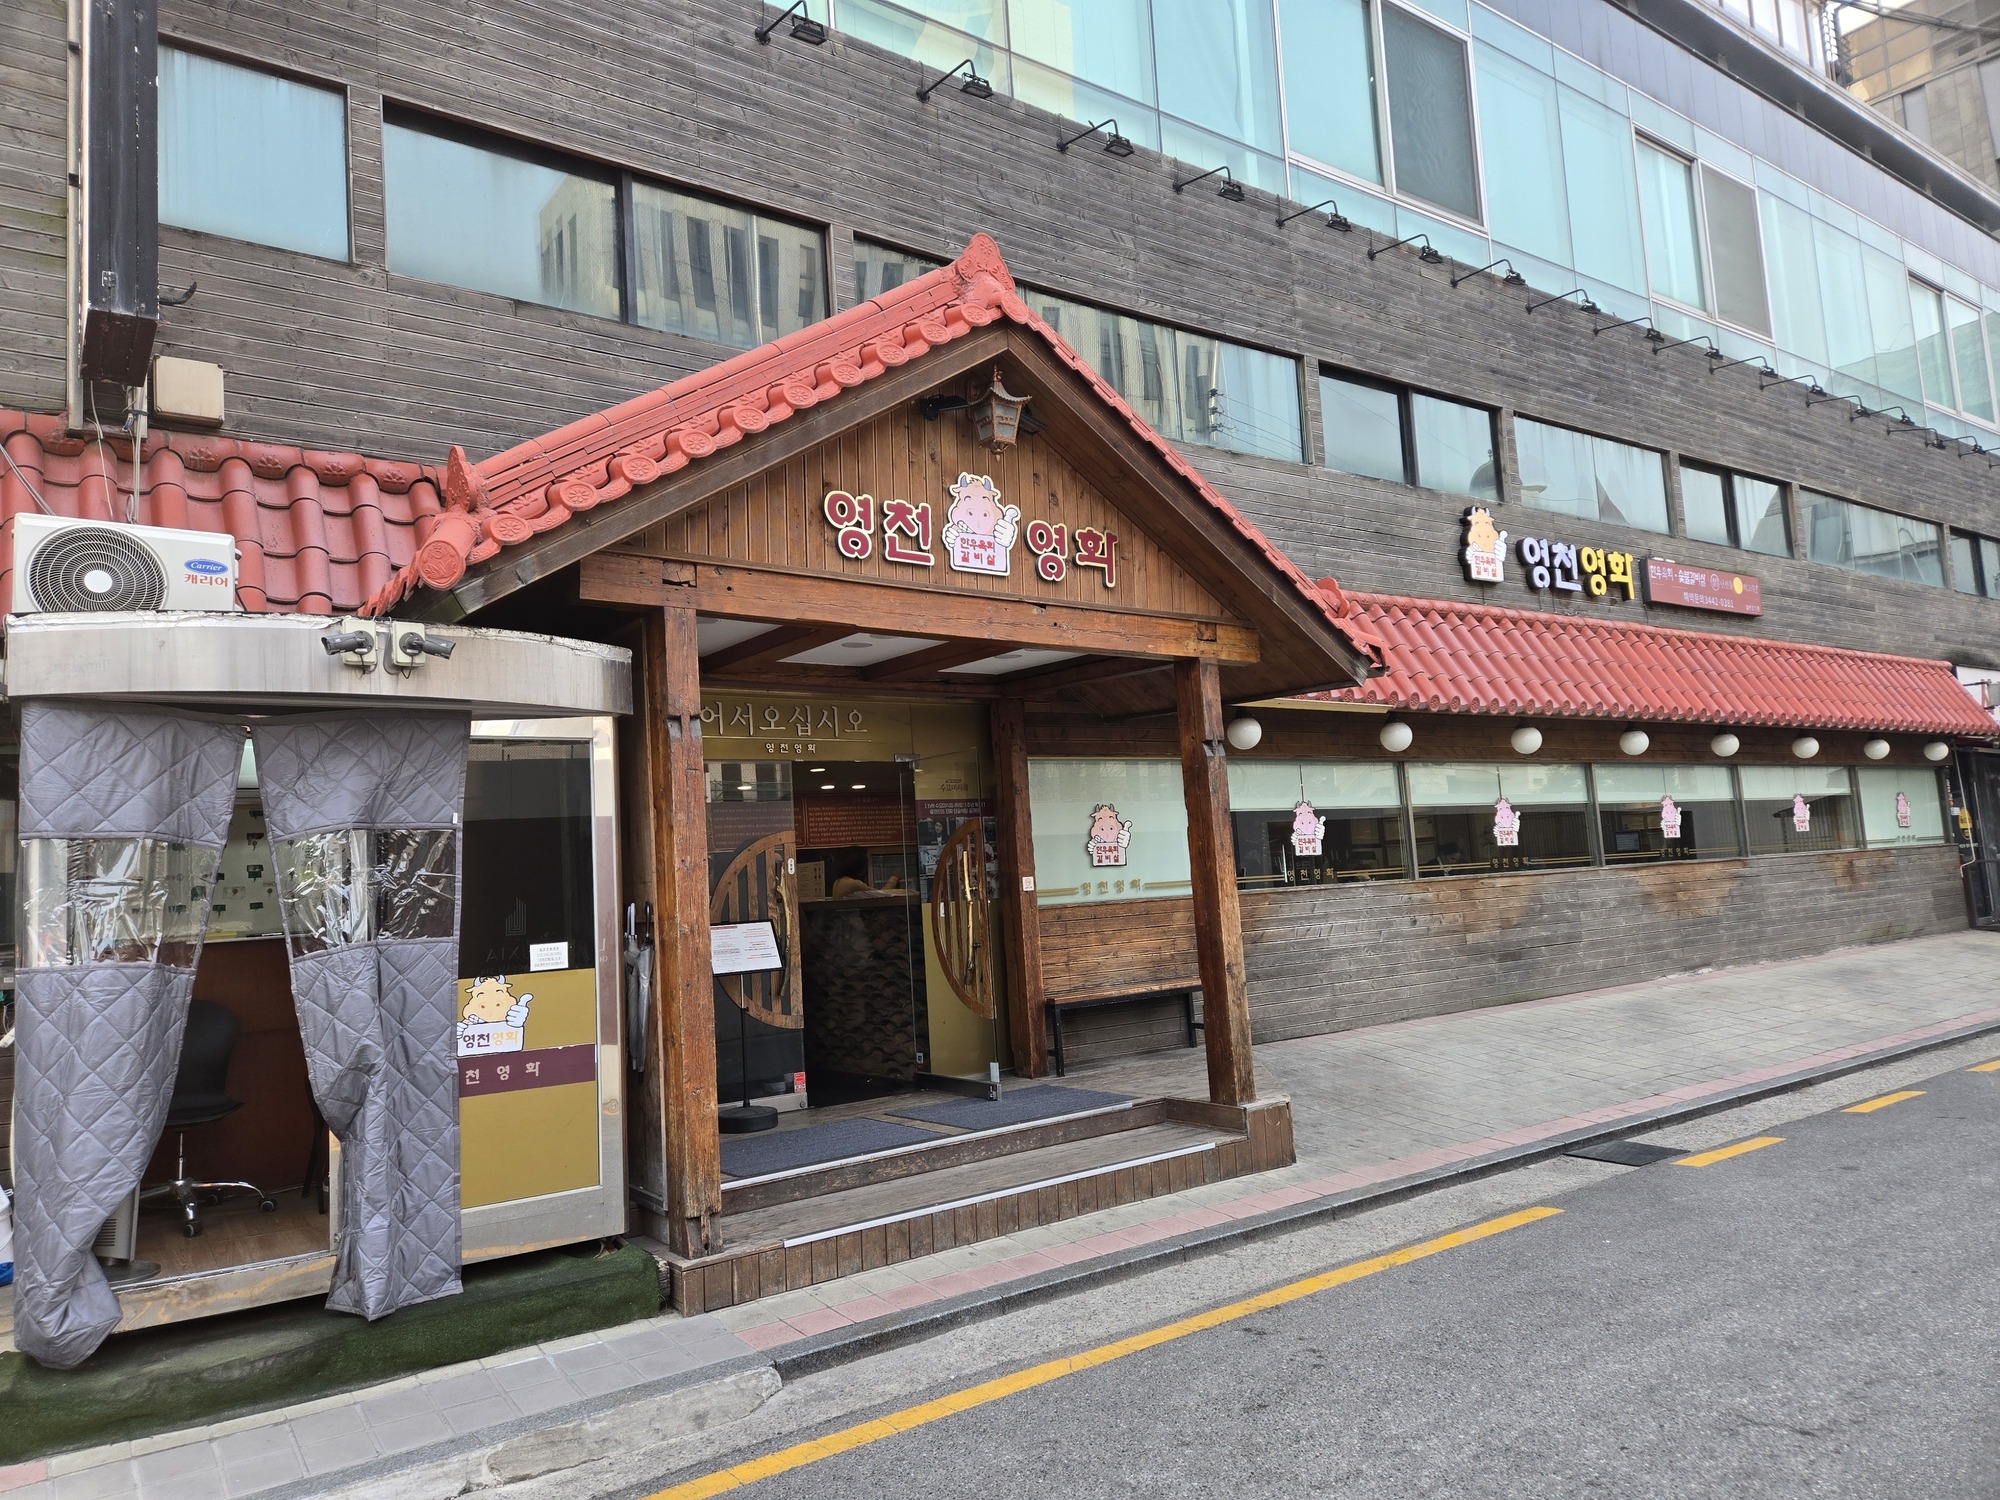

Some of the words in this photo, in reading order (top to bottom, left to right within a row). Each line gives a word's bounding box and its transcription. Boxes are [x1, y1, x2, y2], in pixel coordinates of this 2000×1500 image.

[825, 491, 934, 566] 영천
[1027, 520, 1118, 587] 영화
[960, 537, 996, 553] 한우육회
[190, 561, 223, 571] Carrier
[960, 551, 996, 566] 갈비살
[184, 574, 228, 587] 캐리어
[700, 701, 868, 738] 어서오십시오
